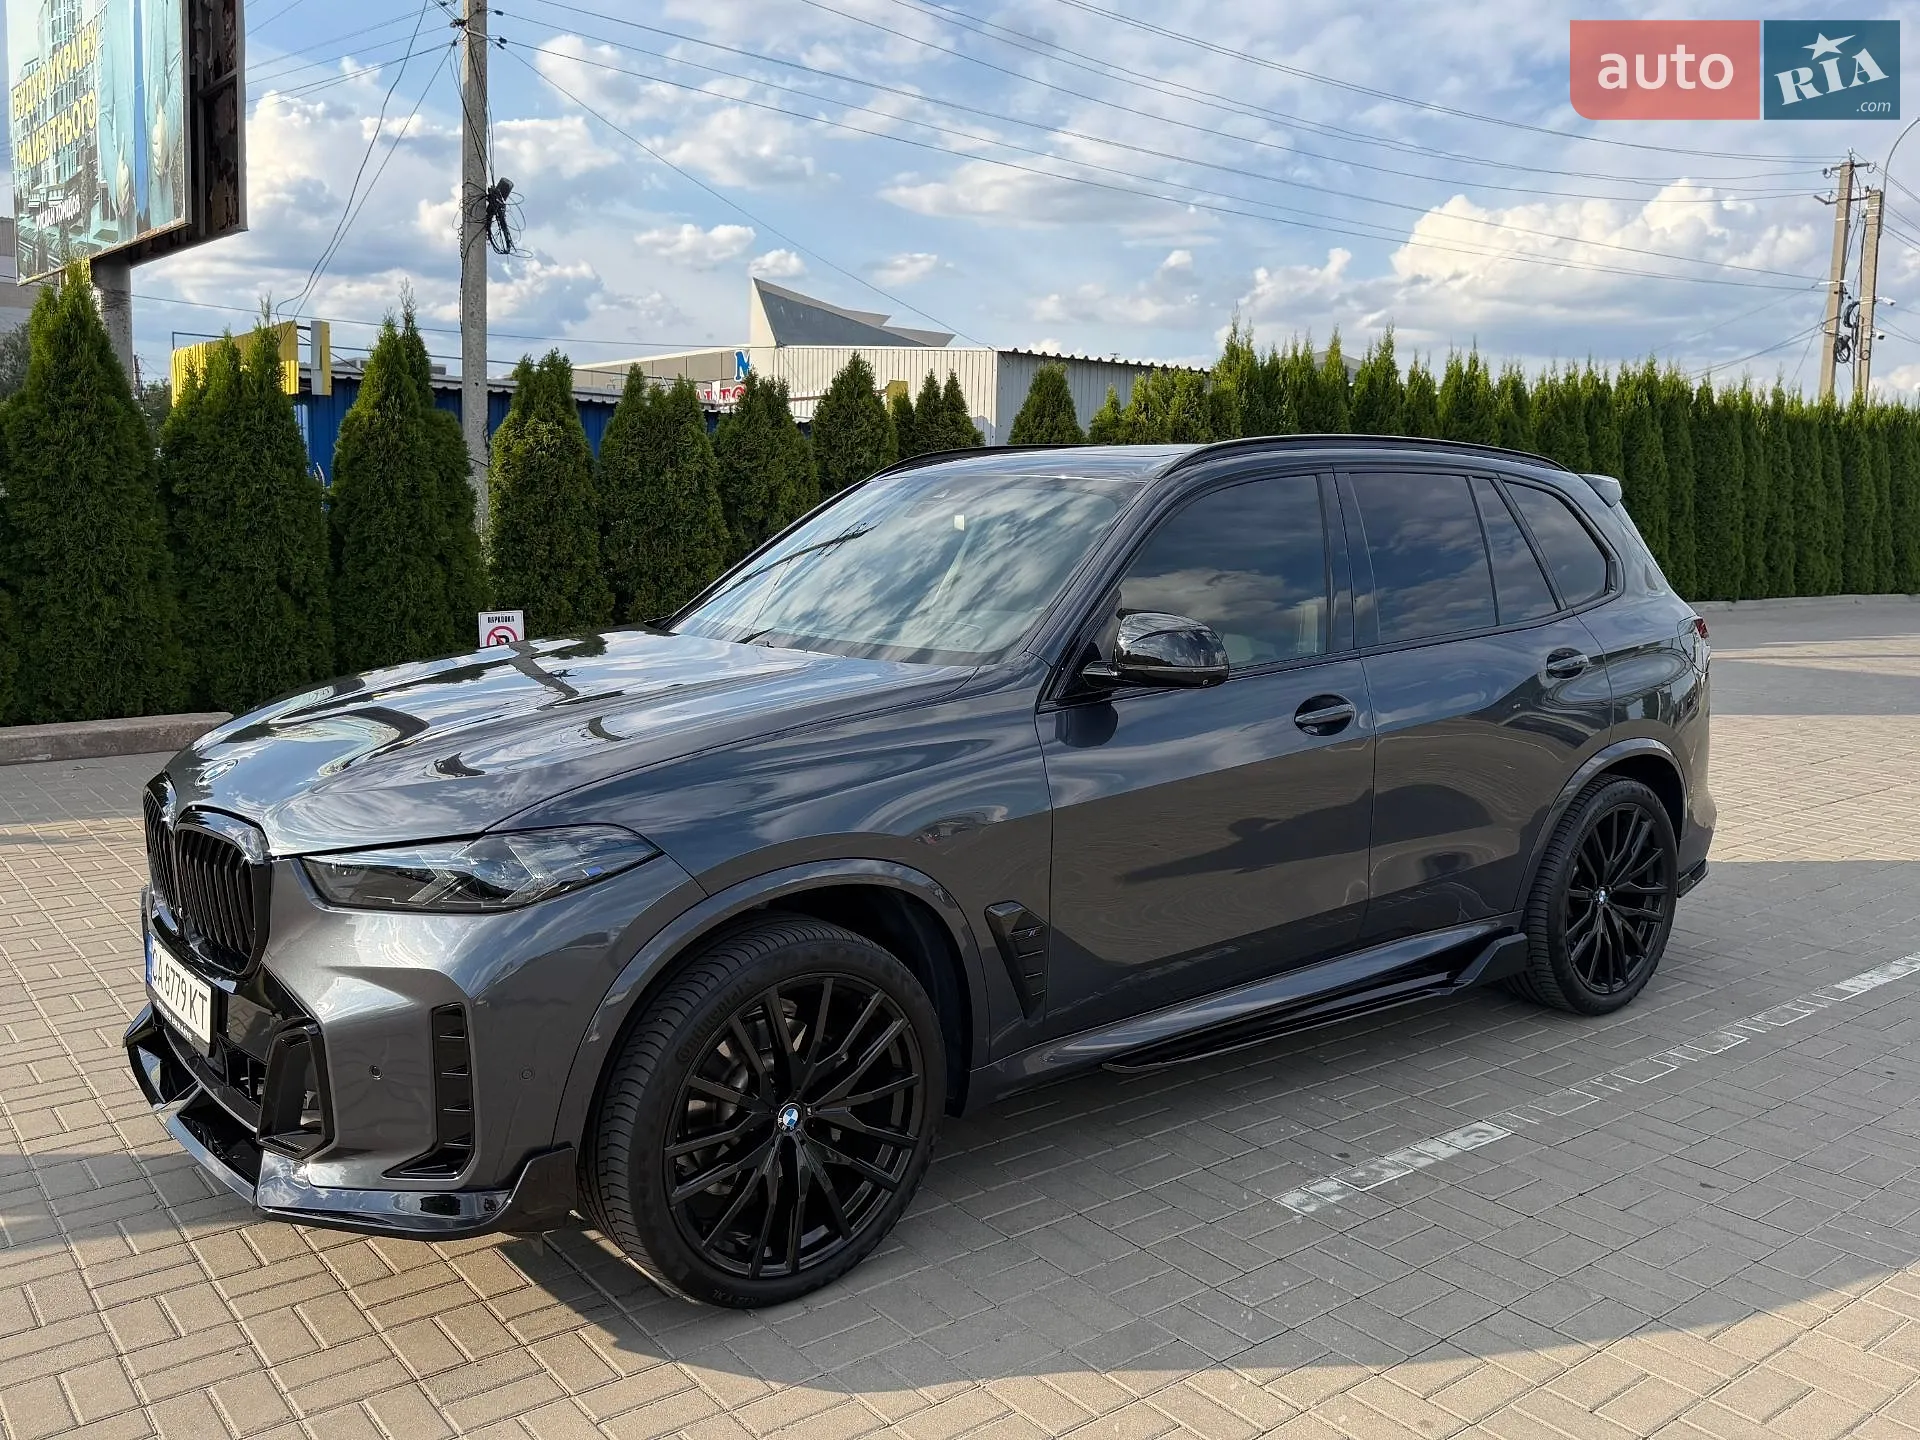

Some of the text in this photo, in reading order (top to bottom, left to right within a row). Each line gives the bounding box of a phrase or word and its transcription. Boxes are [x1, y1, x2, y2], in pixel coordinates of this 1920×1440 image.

[13, 20, 97, 121] БУДУЮ УКРАЇНУ
[18, 89, 96, 169] МАЙБУТНЬОГО
